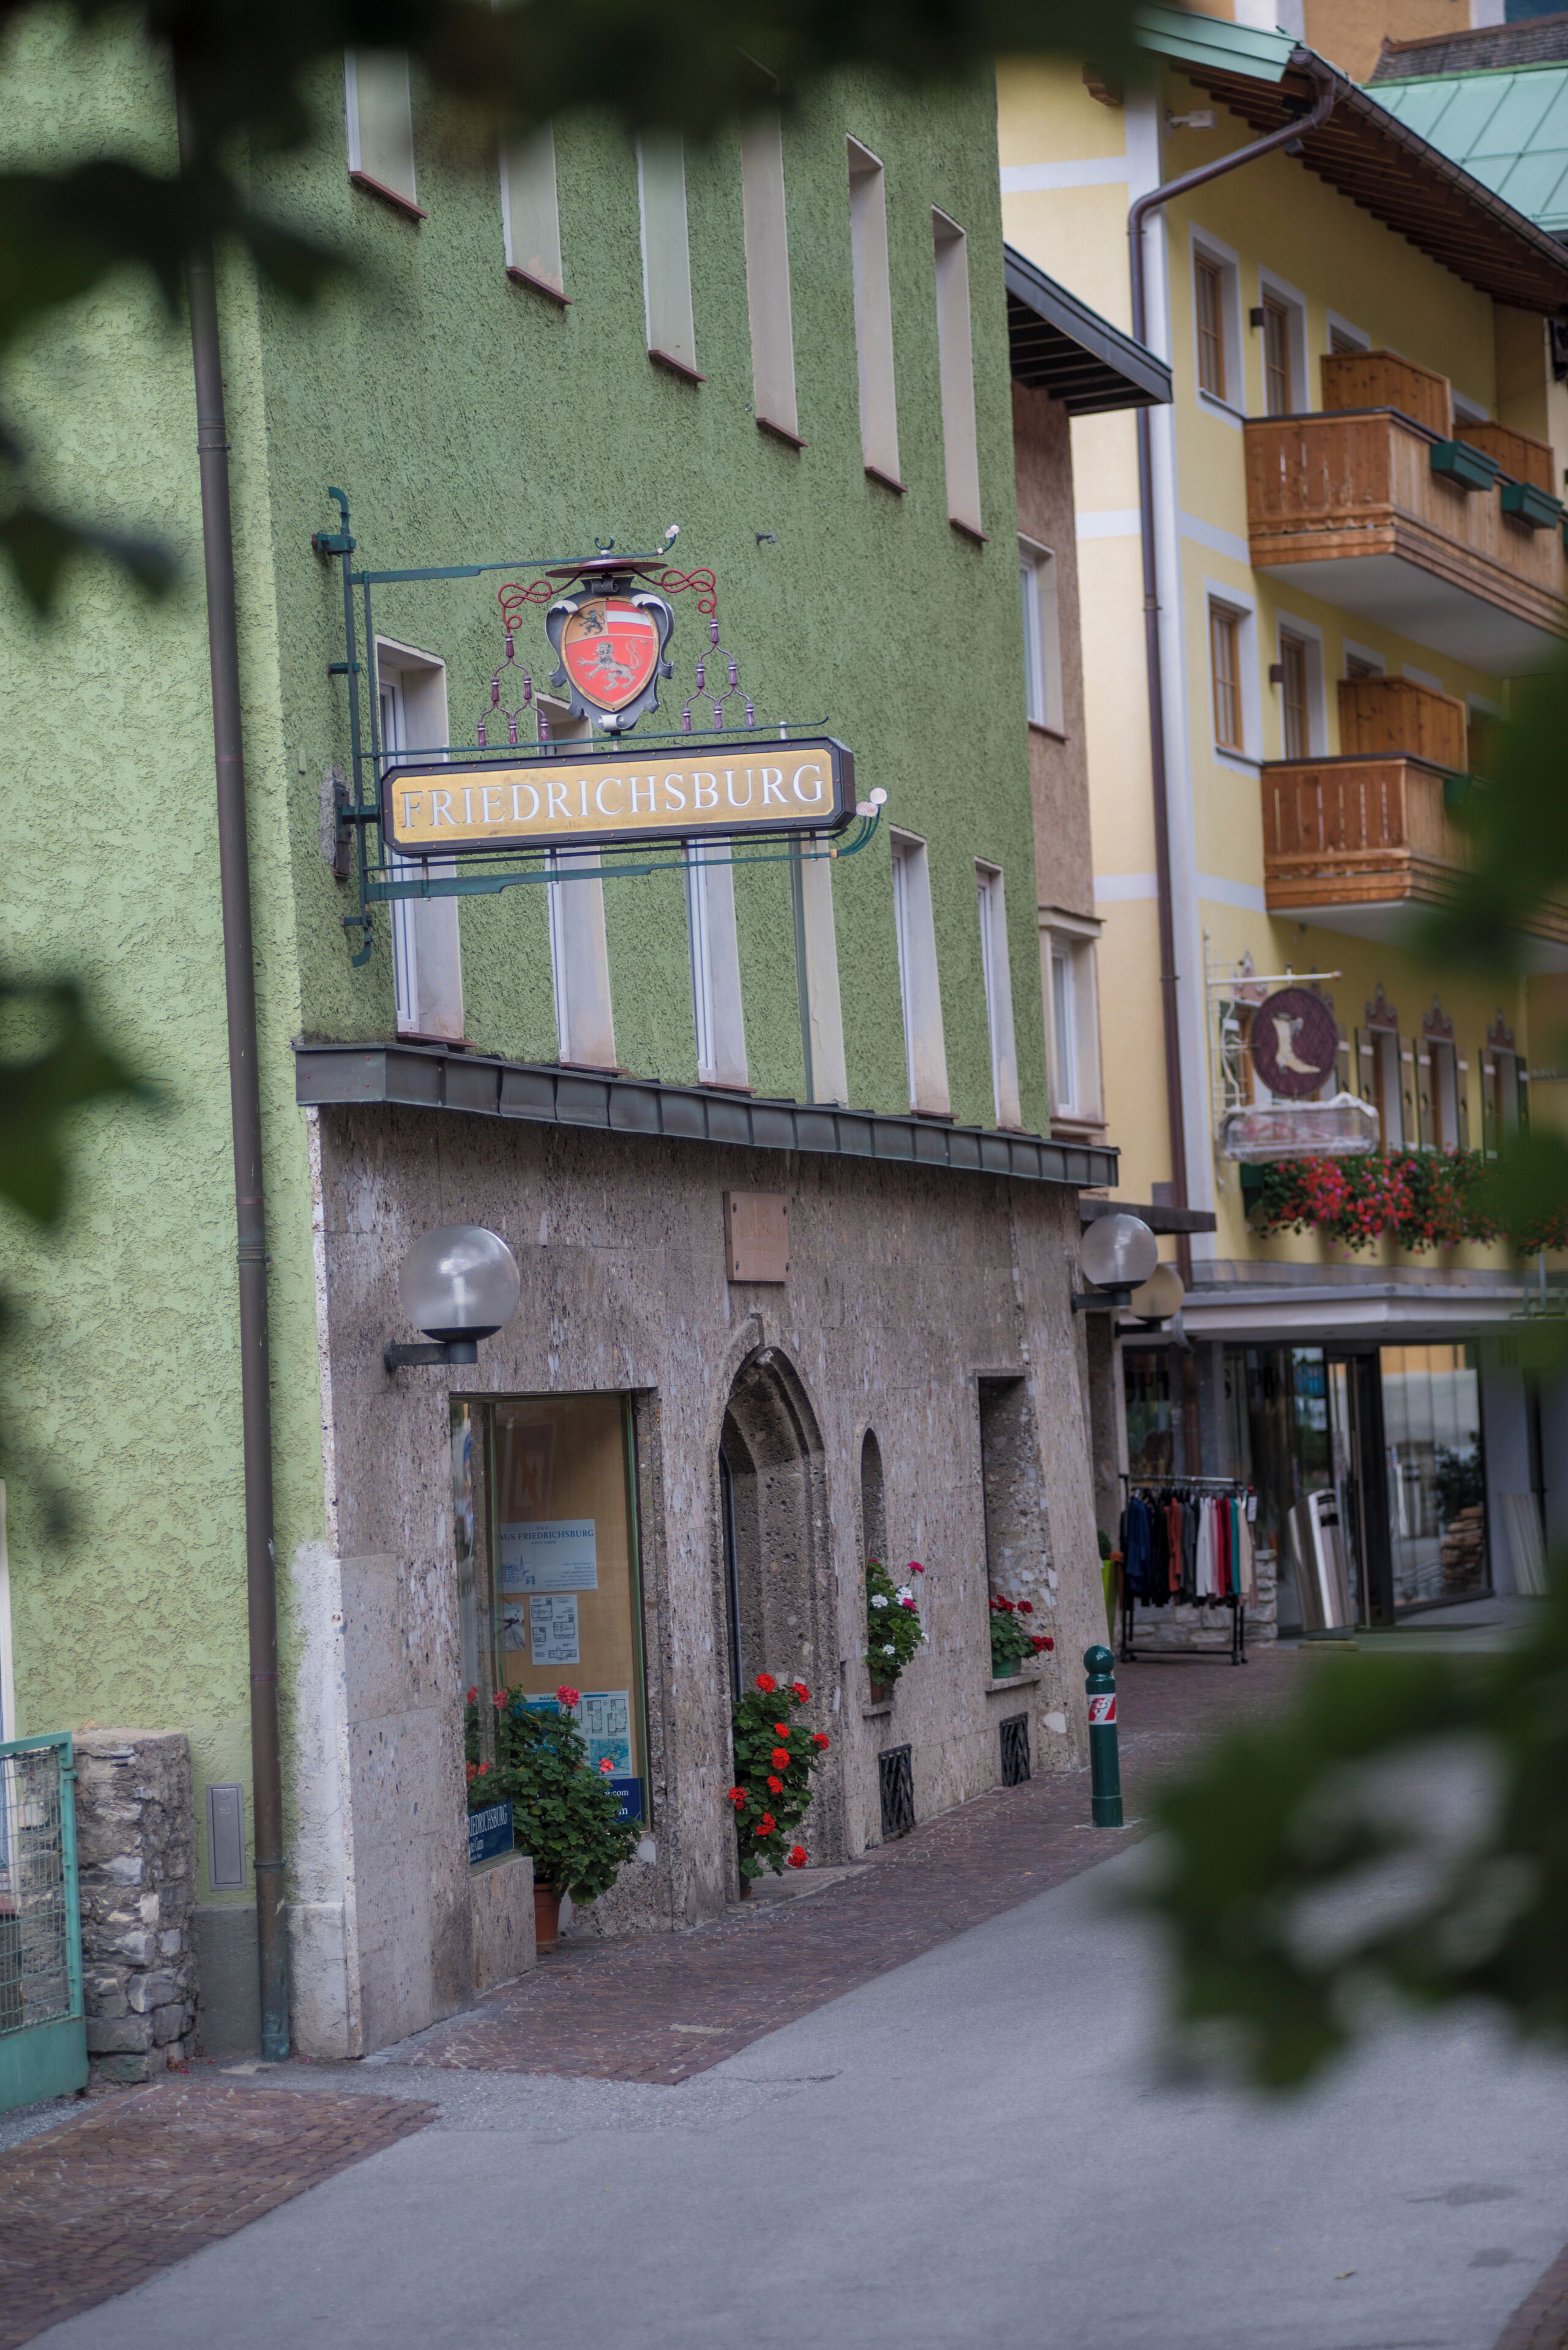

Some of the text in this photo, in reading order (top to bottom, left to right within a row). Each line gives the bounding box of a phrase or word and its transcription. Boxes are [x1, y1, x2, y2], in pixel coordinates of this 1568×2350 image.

[400, 764, 824, 827] FRIEDRICHSBURG
[518, 1530, 594, 1540] FRIEDRICHSBURG
[468, 1805, 507, 1837] RIEDRICHSBURG
